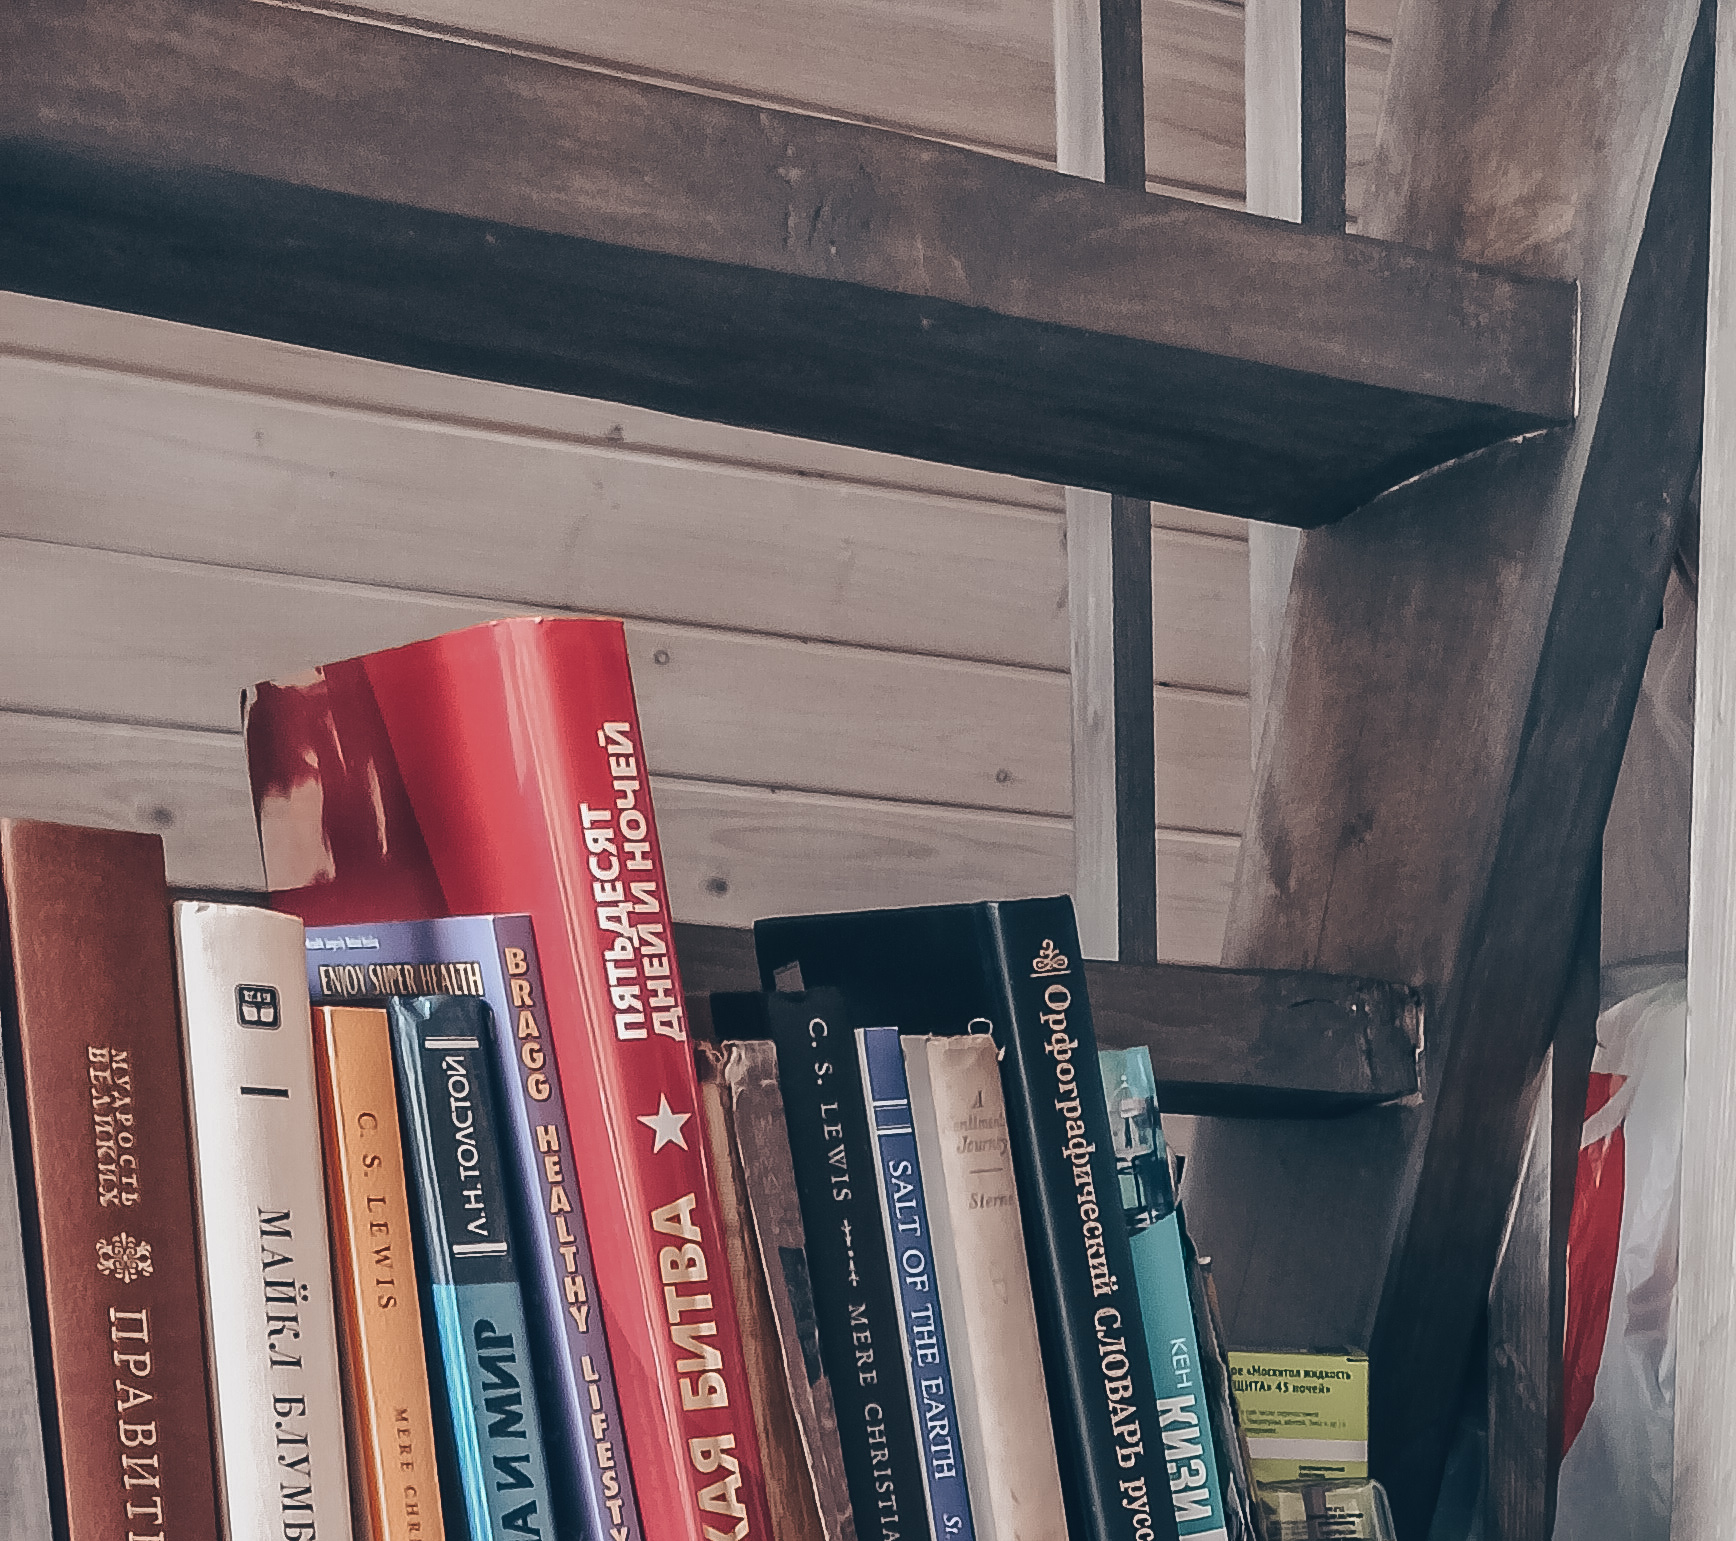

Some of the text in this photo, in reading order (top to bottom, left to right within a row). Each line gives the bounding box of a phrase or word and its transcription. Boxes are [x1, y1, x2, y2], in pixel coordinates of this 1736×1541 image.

[579, 802, 648, 1041] ПЯТЬДЕСЯТ
[597, 721, 686, 1041] ДНЕЙ И НОЧЕЙ
[319, 962, 485, 998] ENJOY SUPER HEALTH
[88, 1046, 120, 1207] ВЕЛИКИХ
[111, 1048, 140, 1207] МУДРОСТЬ
[504, 947, 550, 1101] BRAGG
[536, 1125, 591, 1333] HEALTHY
[820, 1102, 852, 1202] LEWIS
[258, 1208, 310, 1370] МАЙКЛ
[367, 1195, 397, 1310] LEWIS
[1040, 984, 1119, 1298] Орфографический
[1094, 1306, 1145, 1470] СЛОВАРЬ
[651, 1191, 730, 1412] БИТВА
[849, 1303, 878, 1387] MERE
[889, 1160, 957, 1481] SALT OF THE EARTH
[1169, 1337, 1194, 1390] КЕН
[394, 1408, 415, 1473] MERE
[473, 1318, 528, 1441] МИР
[492, 1454, 535, 1493] И
[1156, 1395, 1212, 1523] КИЗИ
